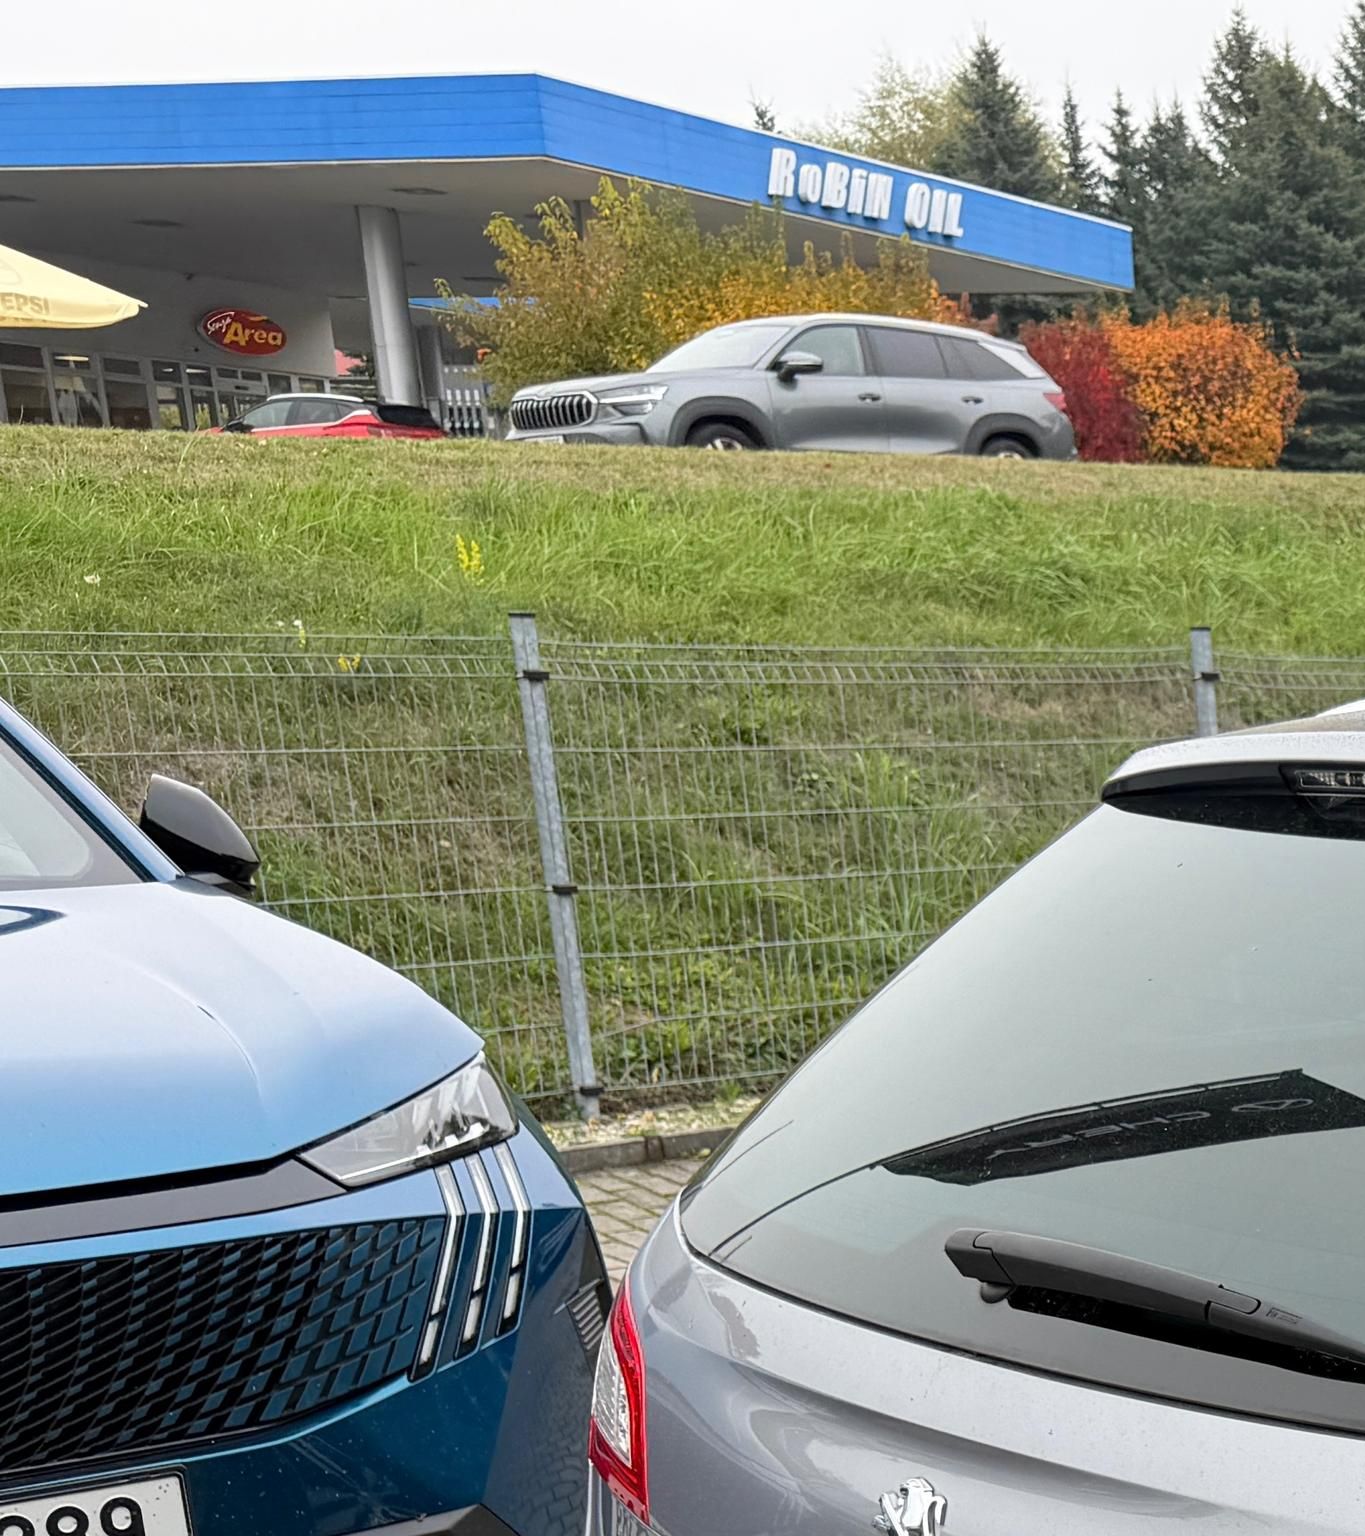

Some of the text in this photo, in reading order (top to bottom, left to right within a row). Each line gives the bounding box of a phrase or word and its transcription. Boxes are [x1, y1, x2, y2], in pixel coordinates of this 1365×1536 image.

[903, 182, 965, 238] OIL
[0, 292, 50, 315] EPSI
[222, 321, 283, 346] Area
